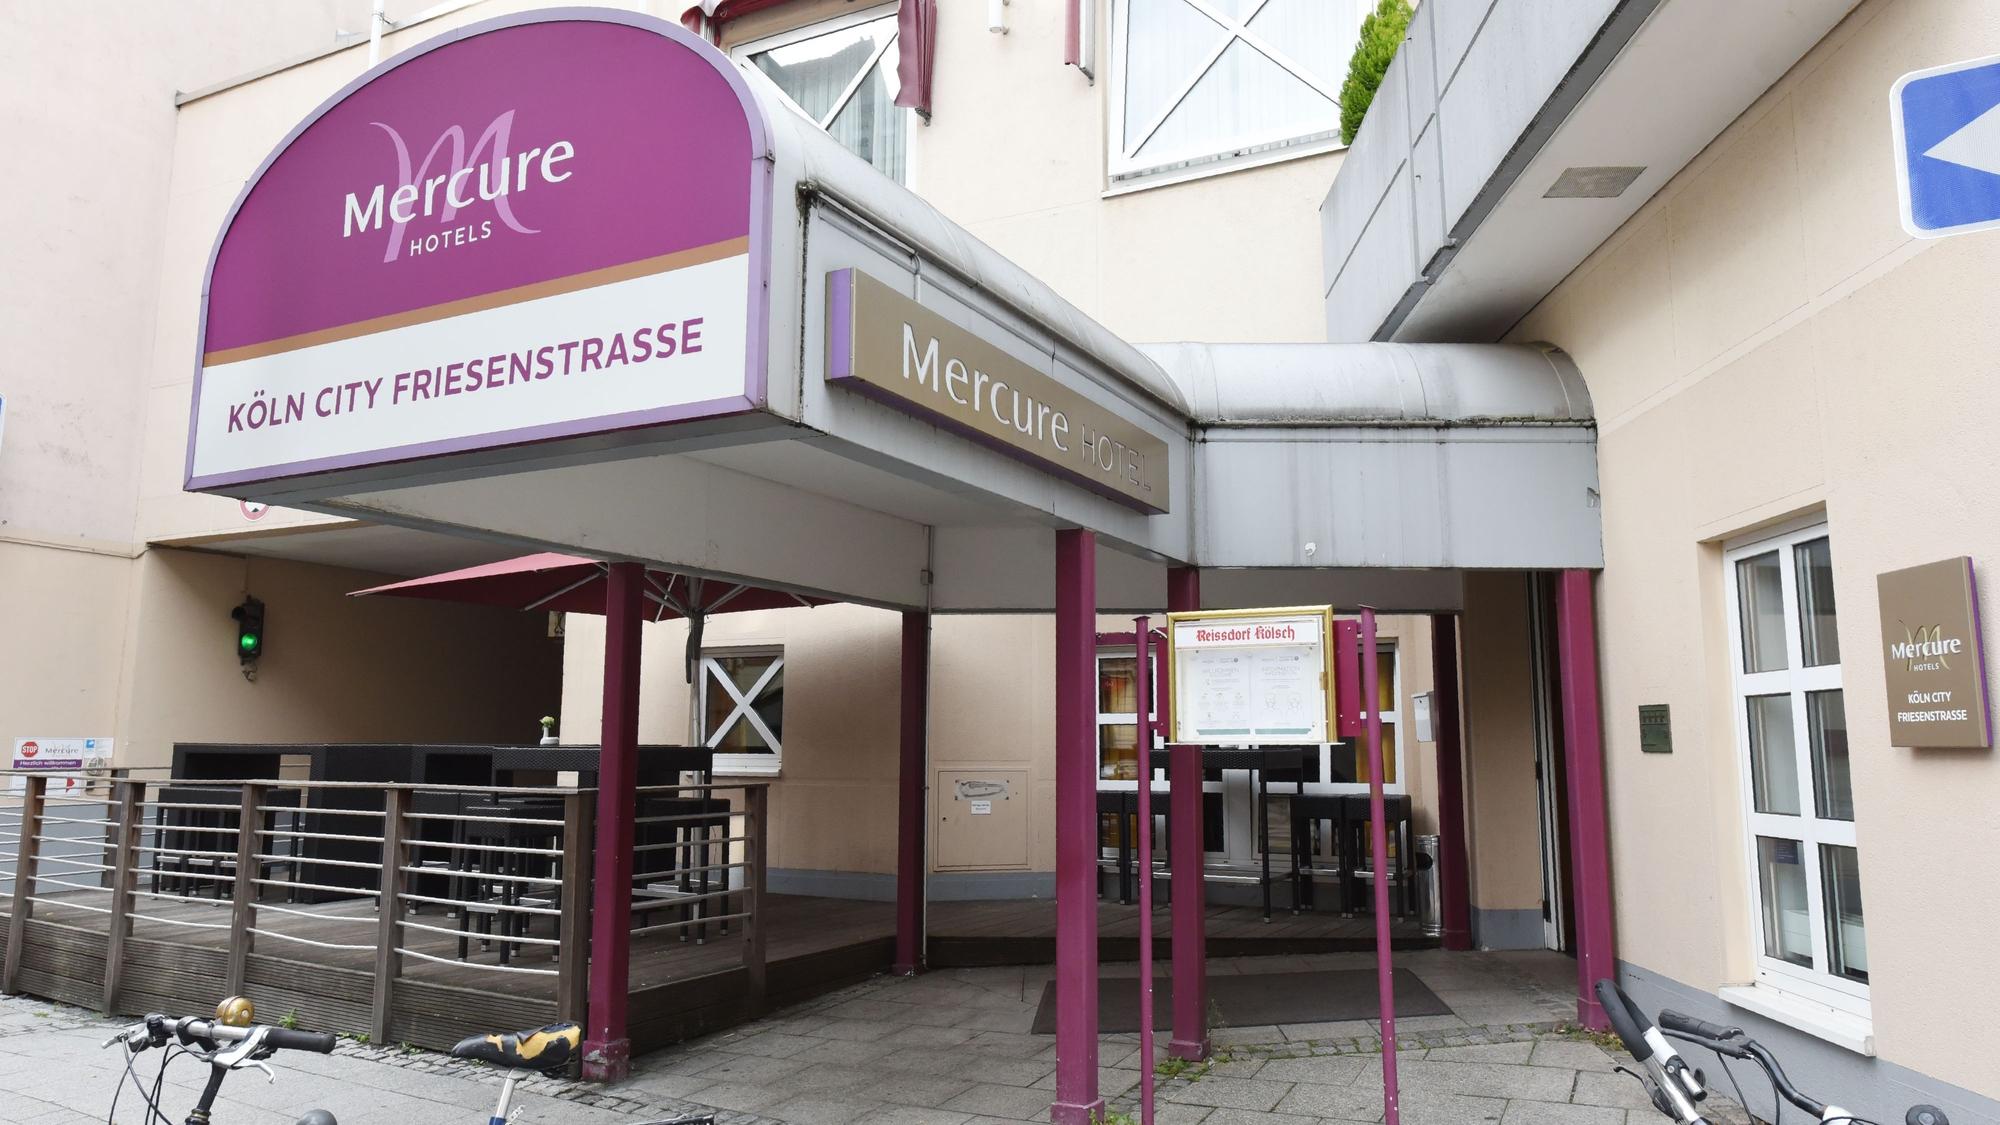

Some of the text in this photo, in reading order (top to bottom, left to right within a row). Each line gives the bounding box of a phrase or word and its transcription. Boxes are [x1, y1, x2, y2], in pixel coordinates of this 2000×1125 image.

[342, 139, 575, 238] Mercure
[409, 220, 492, 257] HOTELS
[228, 316, 704, 433] KÖLN CITY FRIESENSTRASSE
[903, 321, 1151, 492] Mercure HOTEL
[1196, 625, 1295, 642] Reissdorf Kölsch
[1892, 638, 1961, 660] Mercure
[1914, 662, 1940, 672] HOTELS
[1908, 690, 1952, 704] KÖLN CITY
[1897, 710, 1968, 723] FRIESENSTRASSE
[22, 745, 38, 753] STOP
